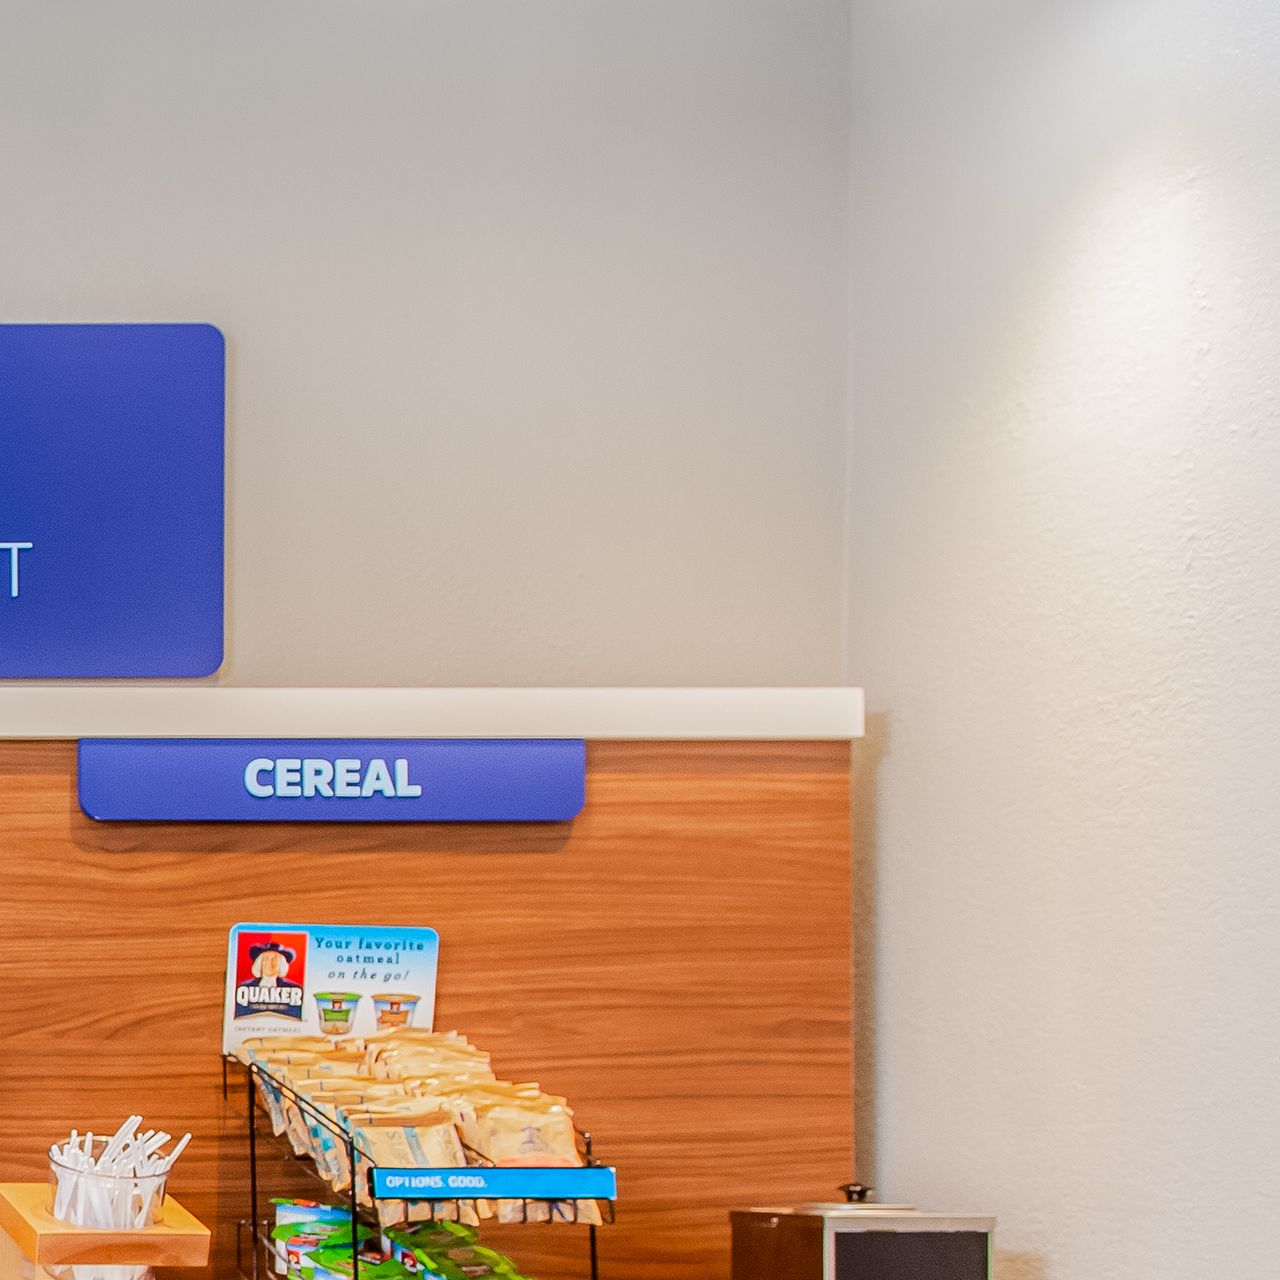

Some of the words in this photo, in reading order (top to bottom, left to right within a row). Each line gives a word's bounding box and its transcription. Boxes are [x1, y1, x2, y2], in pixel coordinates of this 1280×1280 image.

[243, 758, 423, 798] CEREAL
[315, 937, 352, 950] Your
[359, 937, 425, 951] favorite
[336, 953, 400, 965] oatmeal
[327, 969, 345, 980] on
[352, 967, 376, 980] the
[236, 985, 303, 1006] QUAKER
